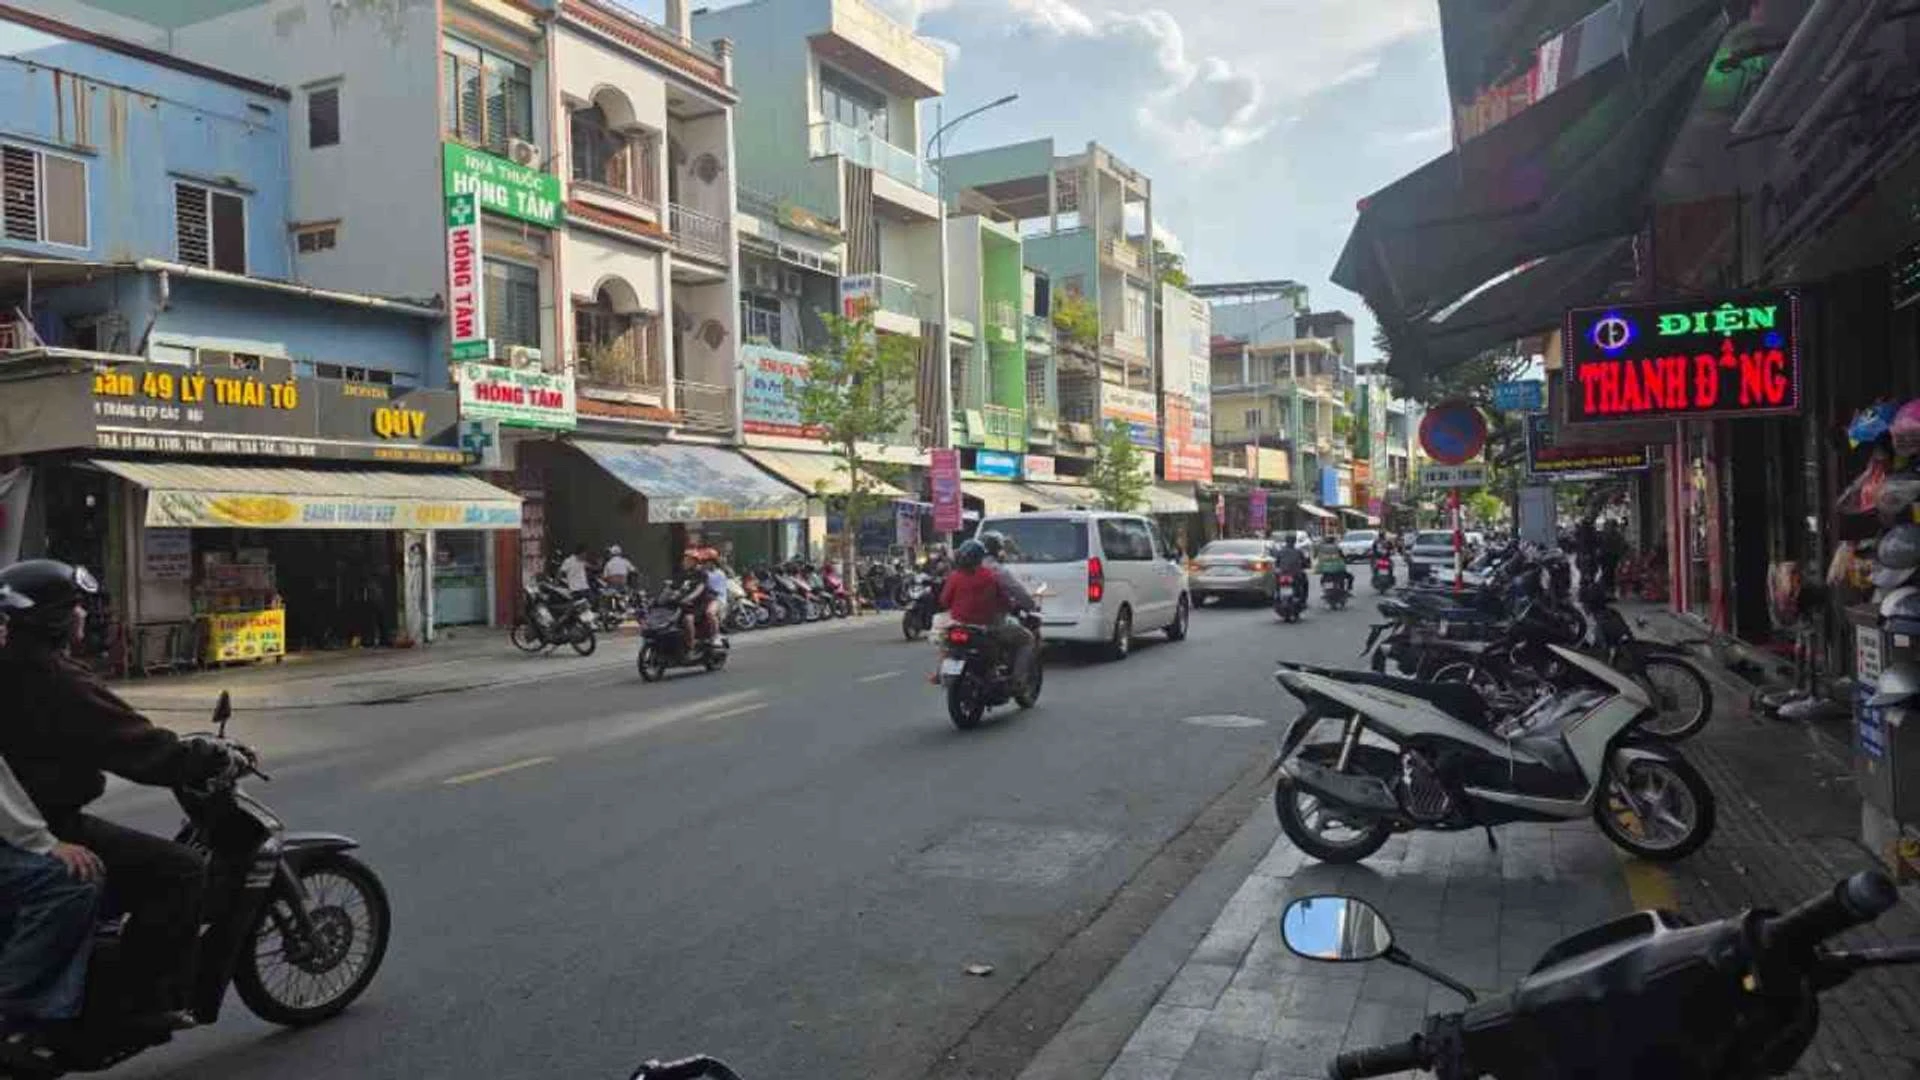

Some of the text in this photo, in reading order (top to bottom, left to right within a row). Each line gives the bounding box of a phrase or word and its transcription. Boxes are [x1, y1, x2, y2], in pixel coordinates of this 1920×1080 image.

[516, 188, 554, 220] TÂM
[455, 293, 474, 338] TÂM
[1657, 303, 1777, 336] ĐIỆN
[143, 371, 173, 399] 49
[180, 371, 205, 402] LÝ
[214, 375, 265, 407] THÁI
[271, 374, 299, 410] TỔ
[529, 387, 563, 409] TÂM
[1579, 356, 1688, 414] THANH
